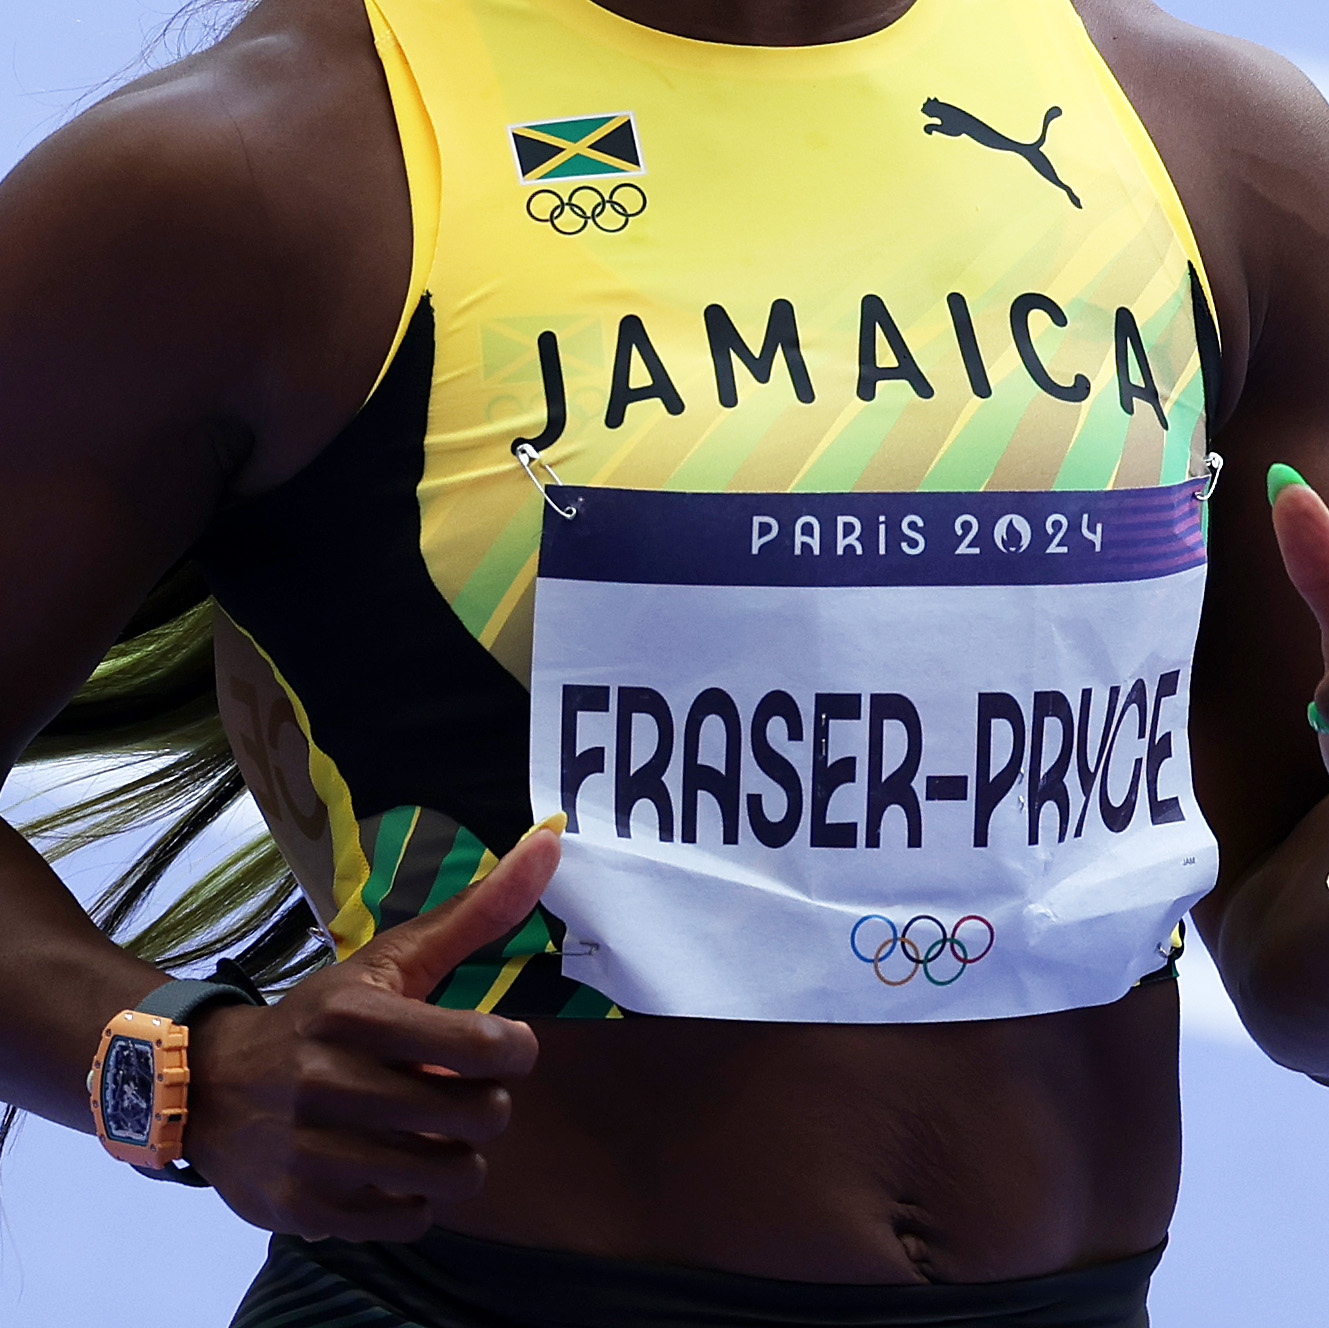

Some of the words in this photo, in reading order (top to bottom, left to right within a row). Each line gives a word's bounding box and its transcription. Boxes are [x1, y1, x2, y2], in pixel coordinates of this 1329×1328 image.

[511, 291, 1169, 452] JAMAICA
[954, 513, 1103, 554] 2024
[561, 670, 1185, 849] FRASER-PRYCE
